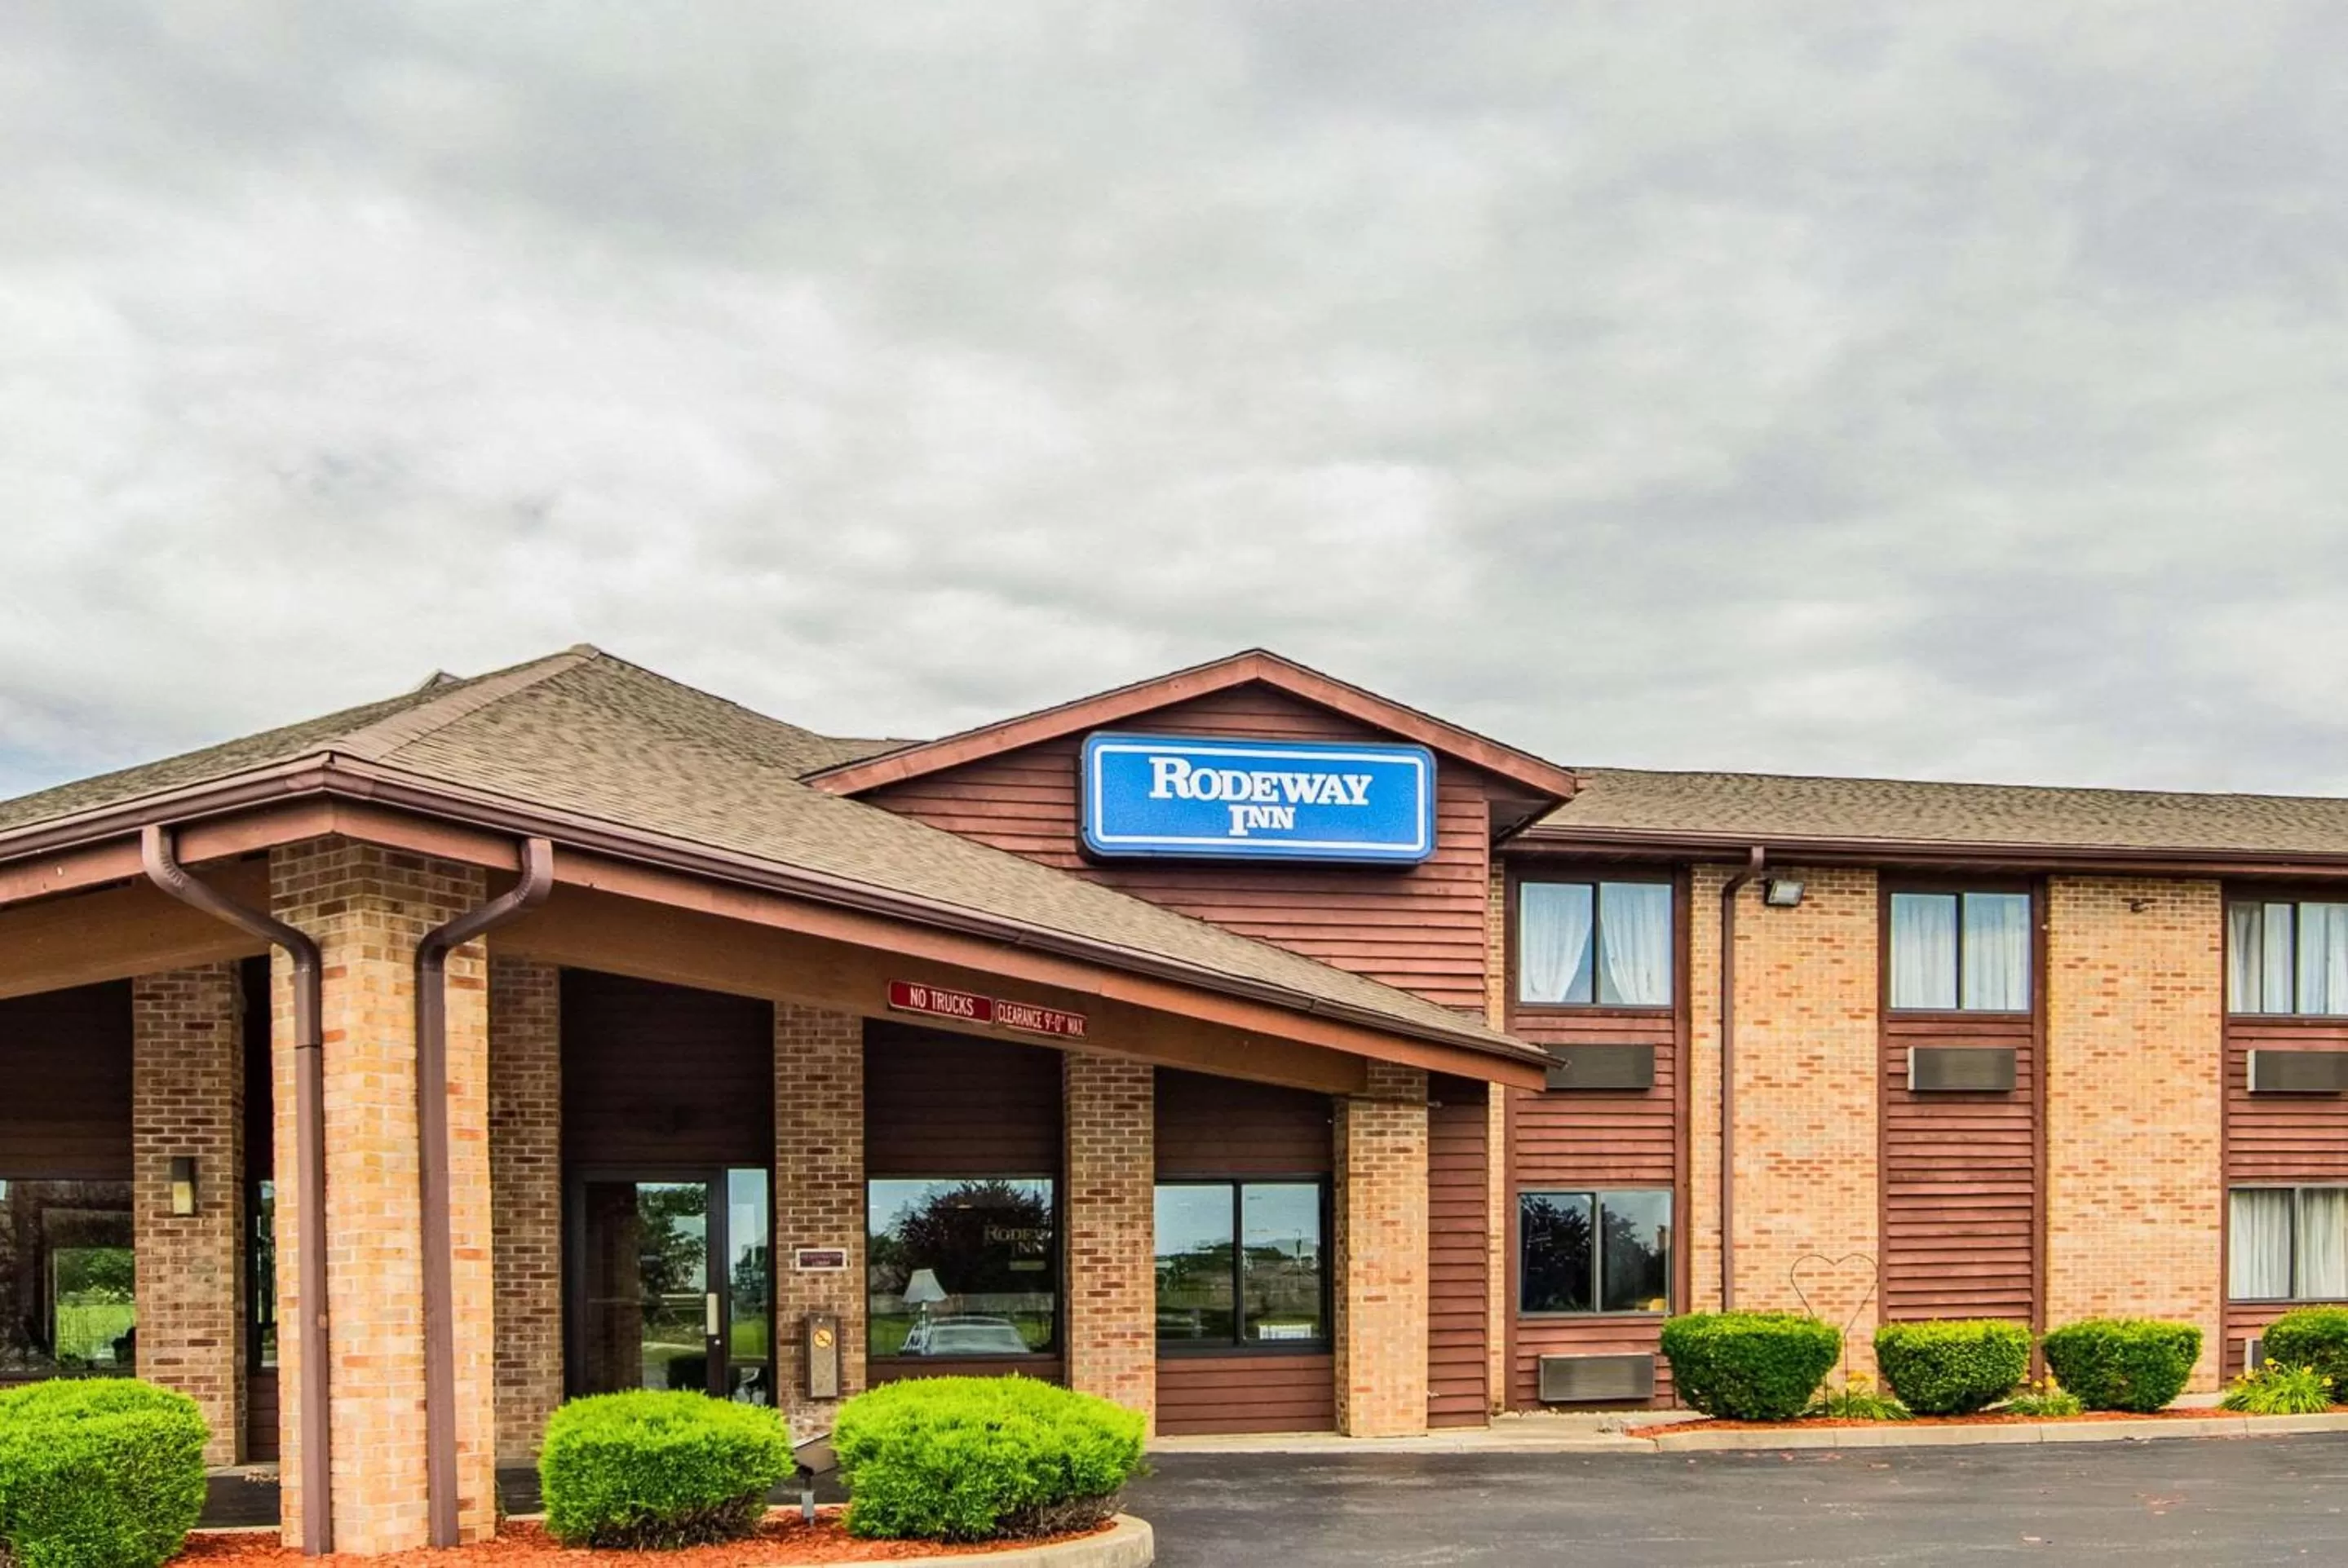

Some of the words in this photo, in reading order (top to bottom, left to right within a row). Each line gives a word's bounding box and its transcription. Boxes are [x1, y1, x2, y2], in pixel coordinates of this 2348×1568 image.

[1147, 756, 1373, 806] RODEWAY
[1228, 805, 1295, 837] INN
[909, 987, 927, 1008] NO
[931, 992, 975, 1017] TRUCKS
[997, 1003, 1042, 1029] CLEARANCE
